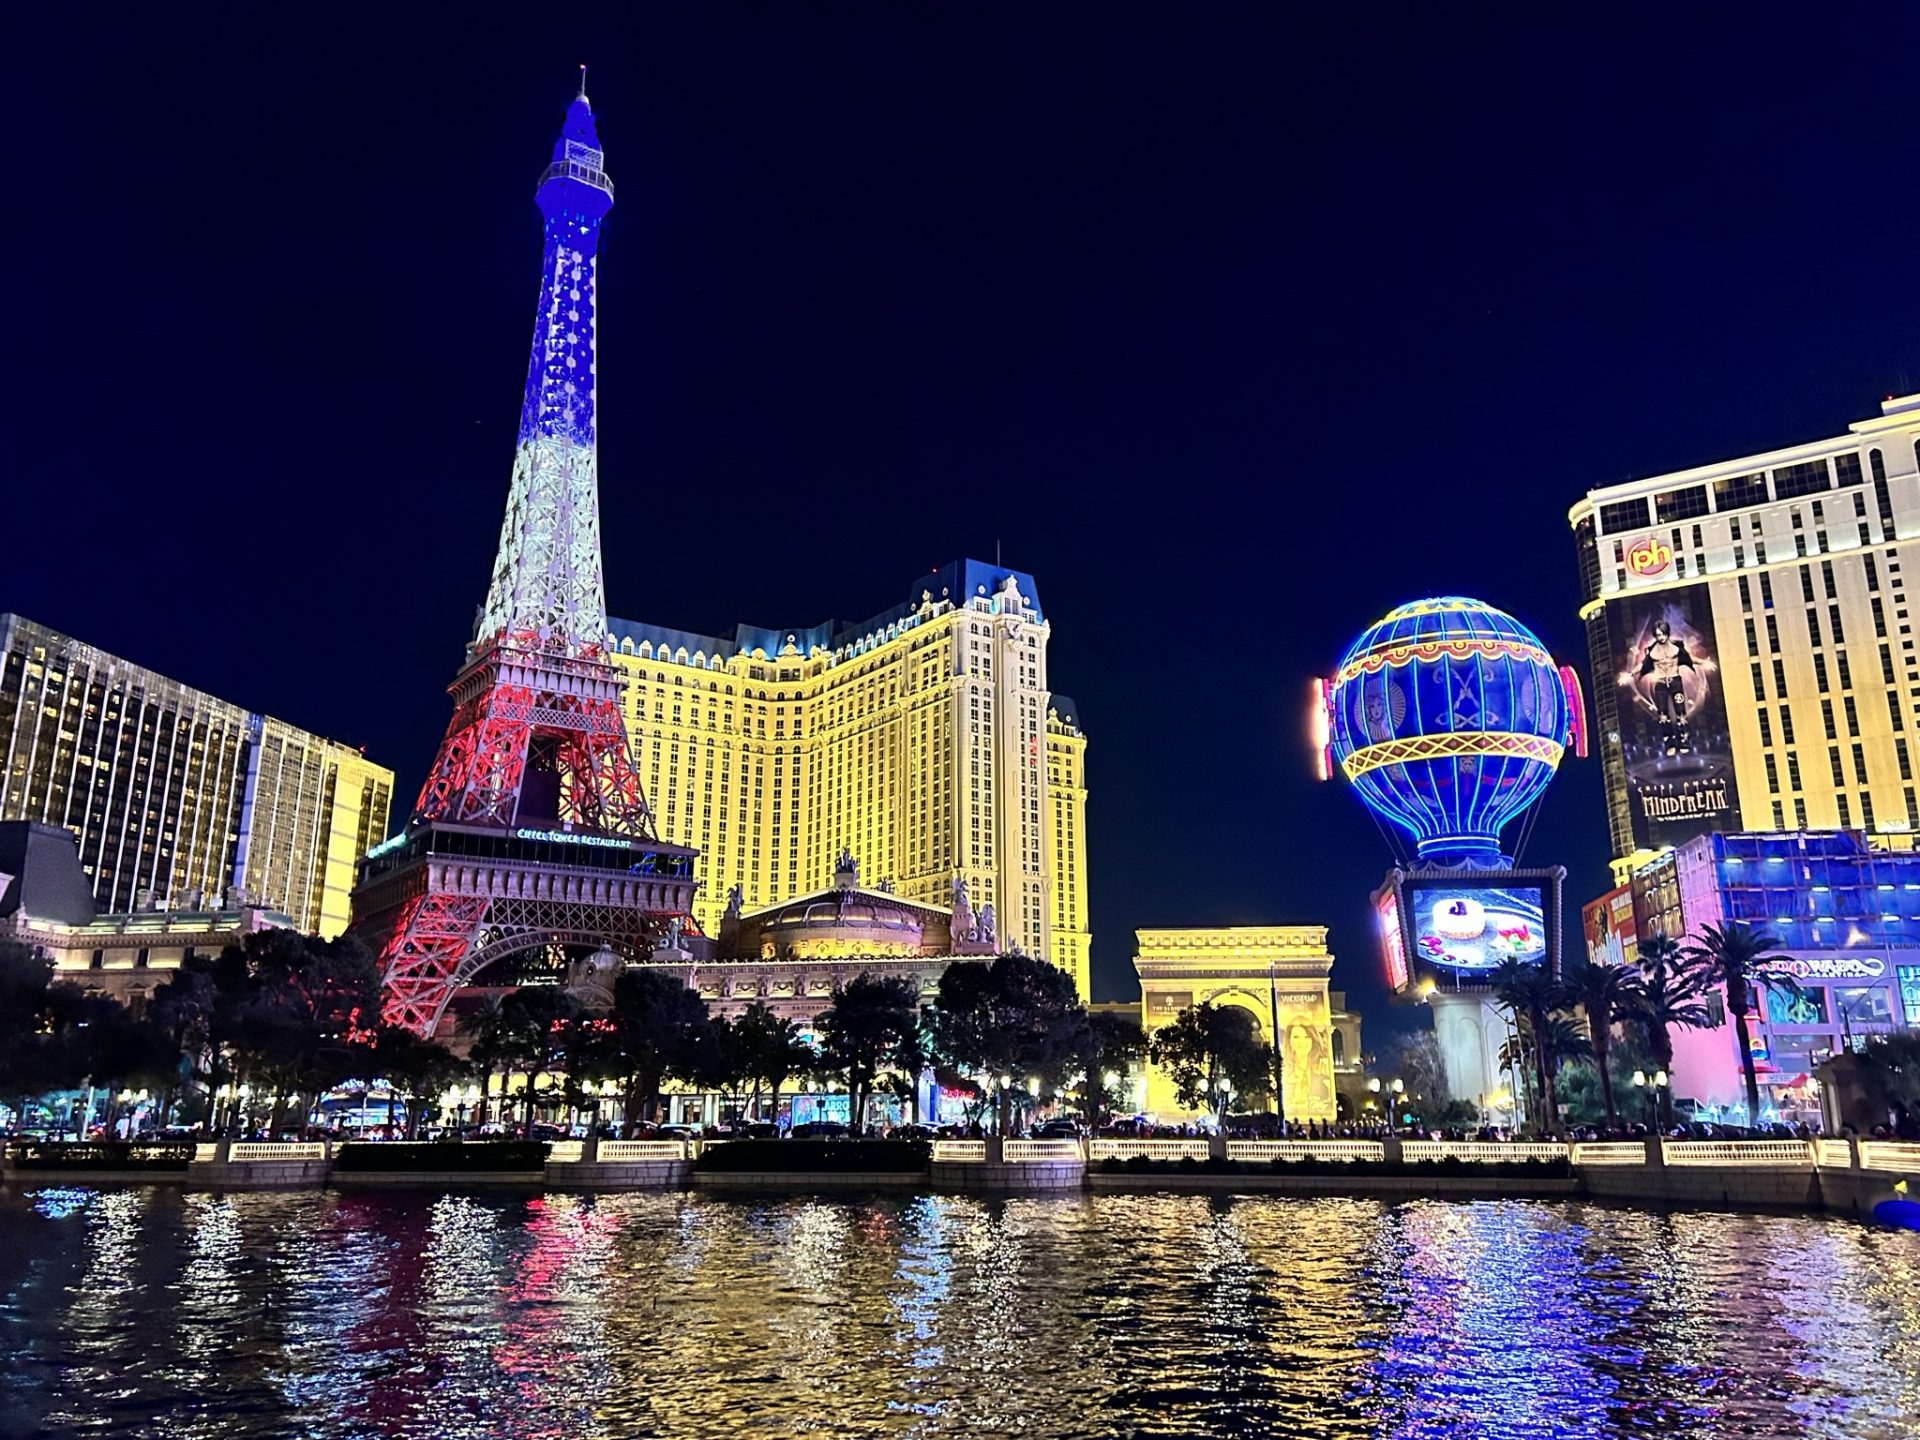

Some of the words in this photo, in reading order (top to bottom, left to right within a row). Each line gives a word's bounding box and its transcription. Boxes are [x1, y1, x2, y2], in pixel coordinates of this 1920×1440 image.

[1632, 538, 1671, 572] ph
[1643, 790, 1728, 816] MINDFREAK
[517, 829, 547, 840] EIFFEL
[548, 831, 580, 843] TOWER
[582, 835, 632, 848] RESTAURANT
